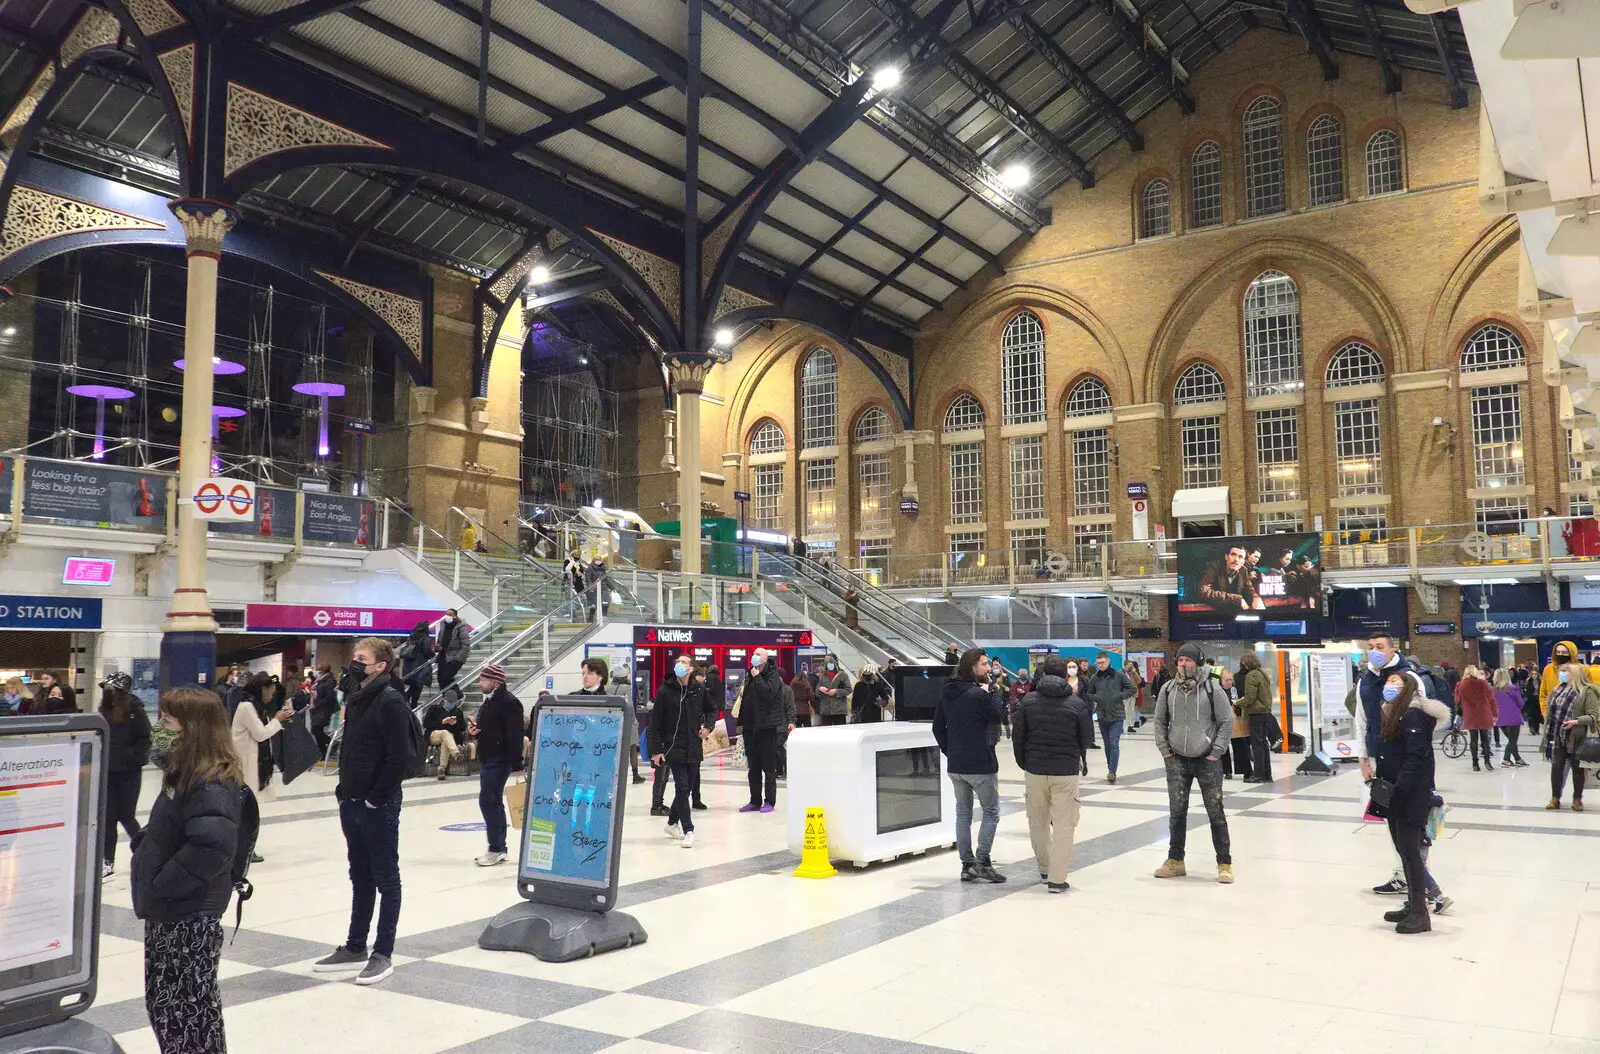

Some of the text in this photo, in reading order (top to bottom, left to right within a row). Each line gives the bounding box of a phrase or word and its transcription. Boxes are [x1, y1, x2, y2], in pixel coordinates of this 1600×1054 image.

[32, 468, 97, 484] Looking for a
[31, 480, 106, 496] less busy train?
[310, 500, 344, 513] Nice one,
[310, 510, 353, 523] East Anglia.
[17, 605, 83, 620] STATION
[333, 619, 357, 627] centre
[1520, 620, 1530, 629] to
[1532, 620, 1569, 629] London
[658, 629, 693, 642] NatWest
[545, 713, 587, 732] Talking
[541, 737, 583, 757] change
[0, 758, 65, 773] Alterations.
